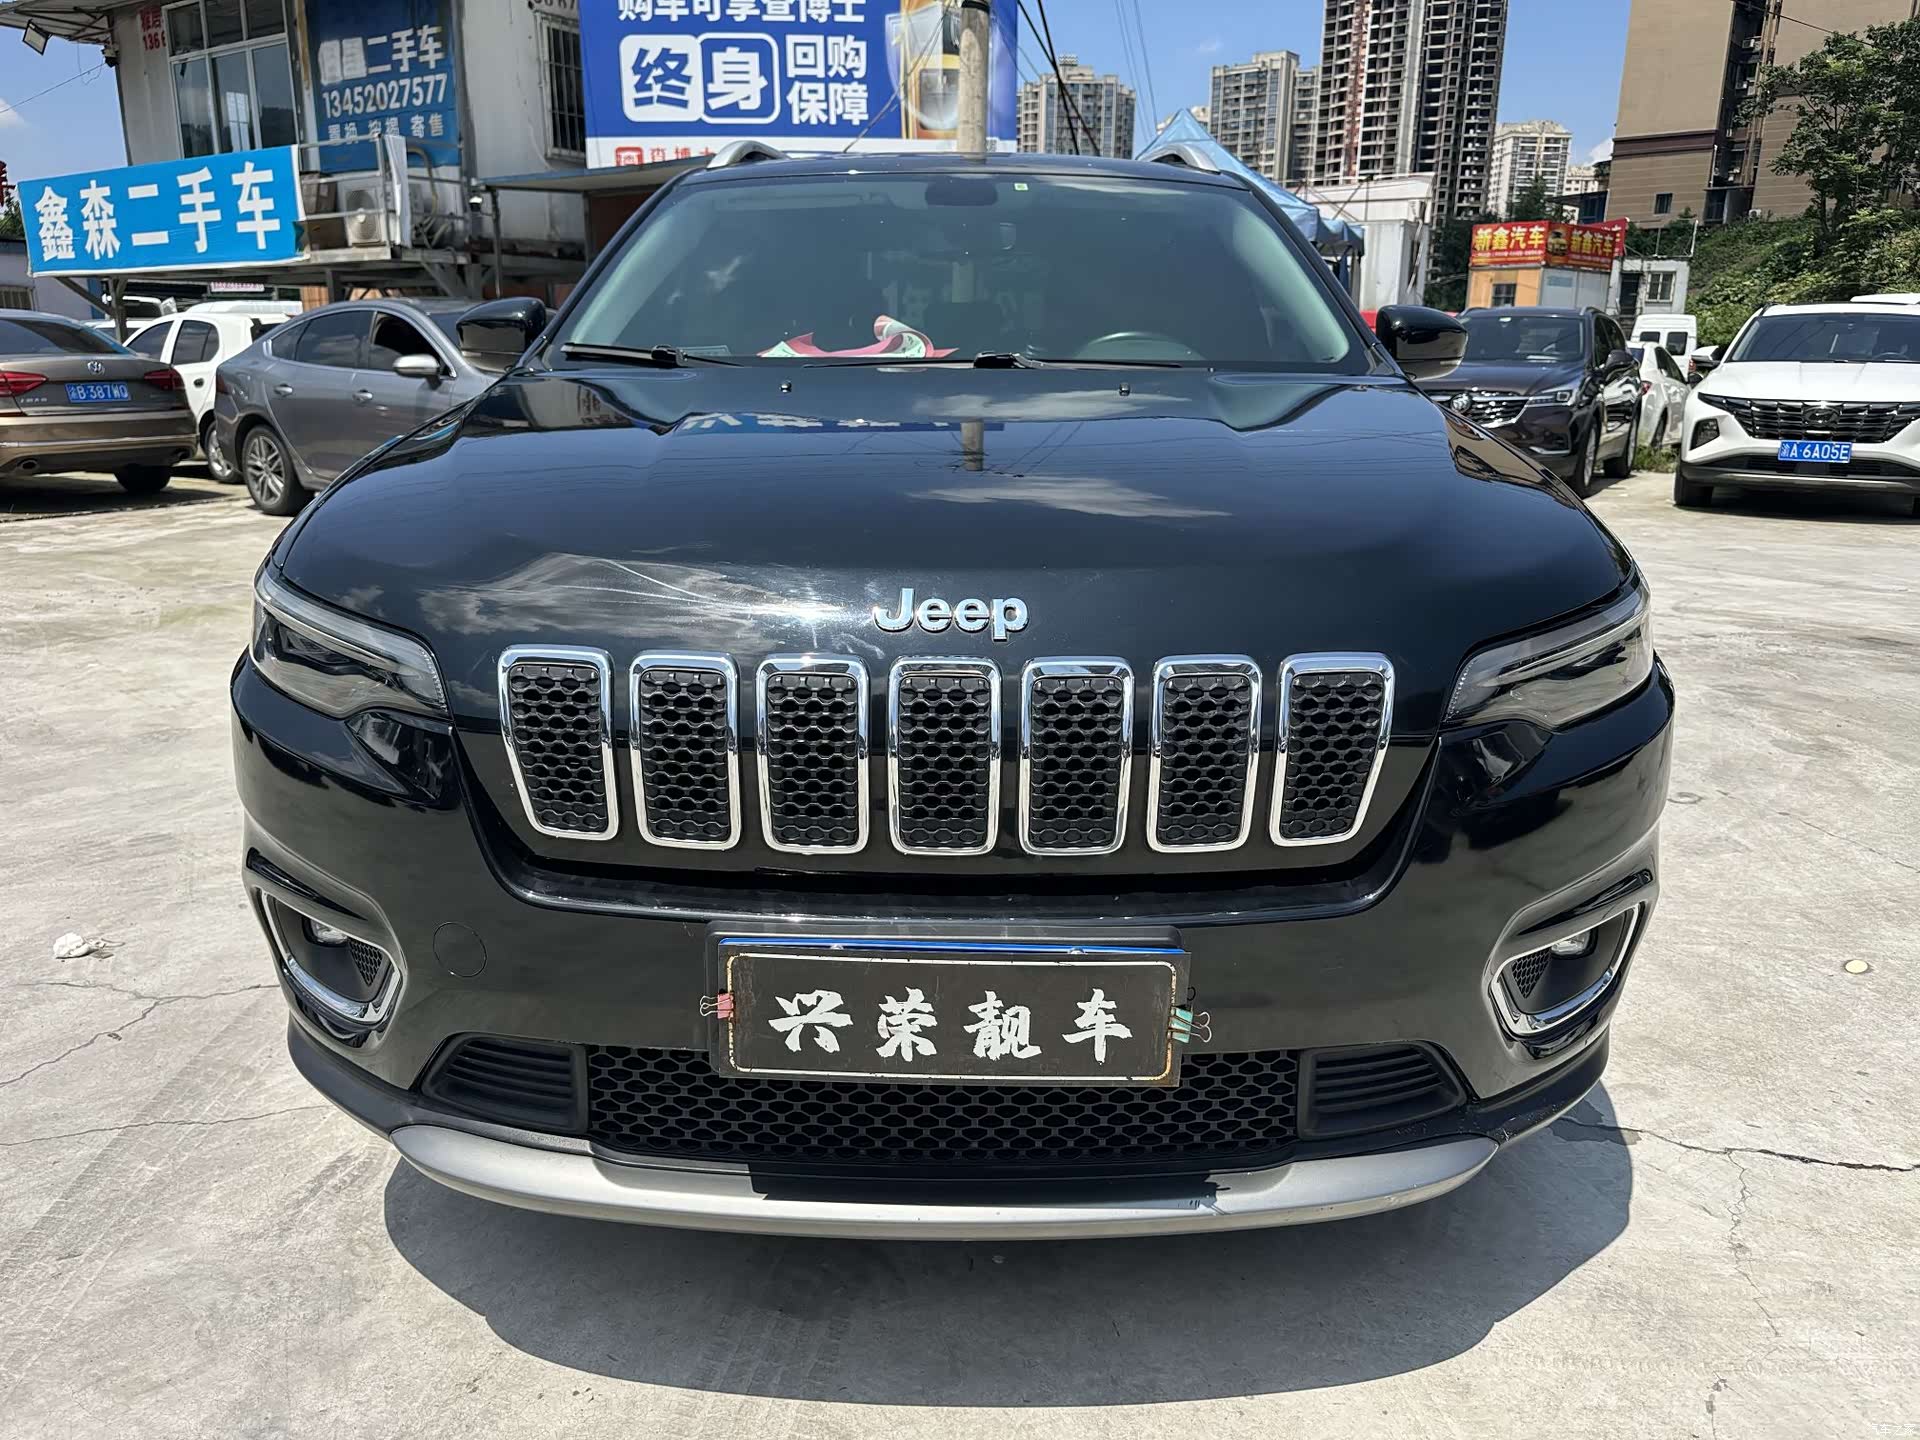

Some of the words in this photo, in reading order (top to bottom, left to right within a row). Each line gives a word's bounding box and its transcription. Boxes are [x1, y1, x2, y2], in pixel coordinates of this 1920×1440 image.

[631, 46, 768, 111] 终身
[785, 34, 868, 79] 回购
[322, 72, 448, 119] 13452027577
[786, 80, 869, 126] 保障
[34, 160, 282, 262] 鑫森二手车
[1474, 225, 1546, 251] 新鑫汽车
[1570, 228, 1614, 256] 新鑫汽车
[872, 587, 1029, 642] Jeep
[767, 985, 1133, 1065] 兴荣靓车
